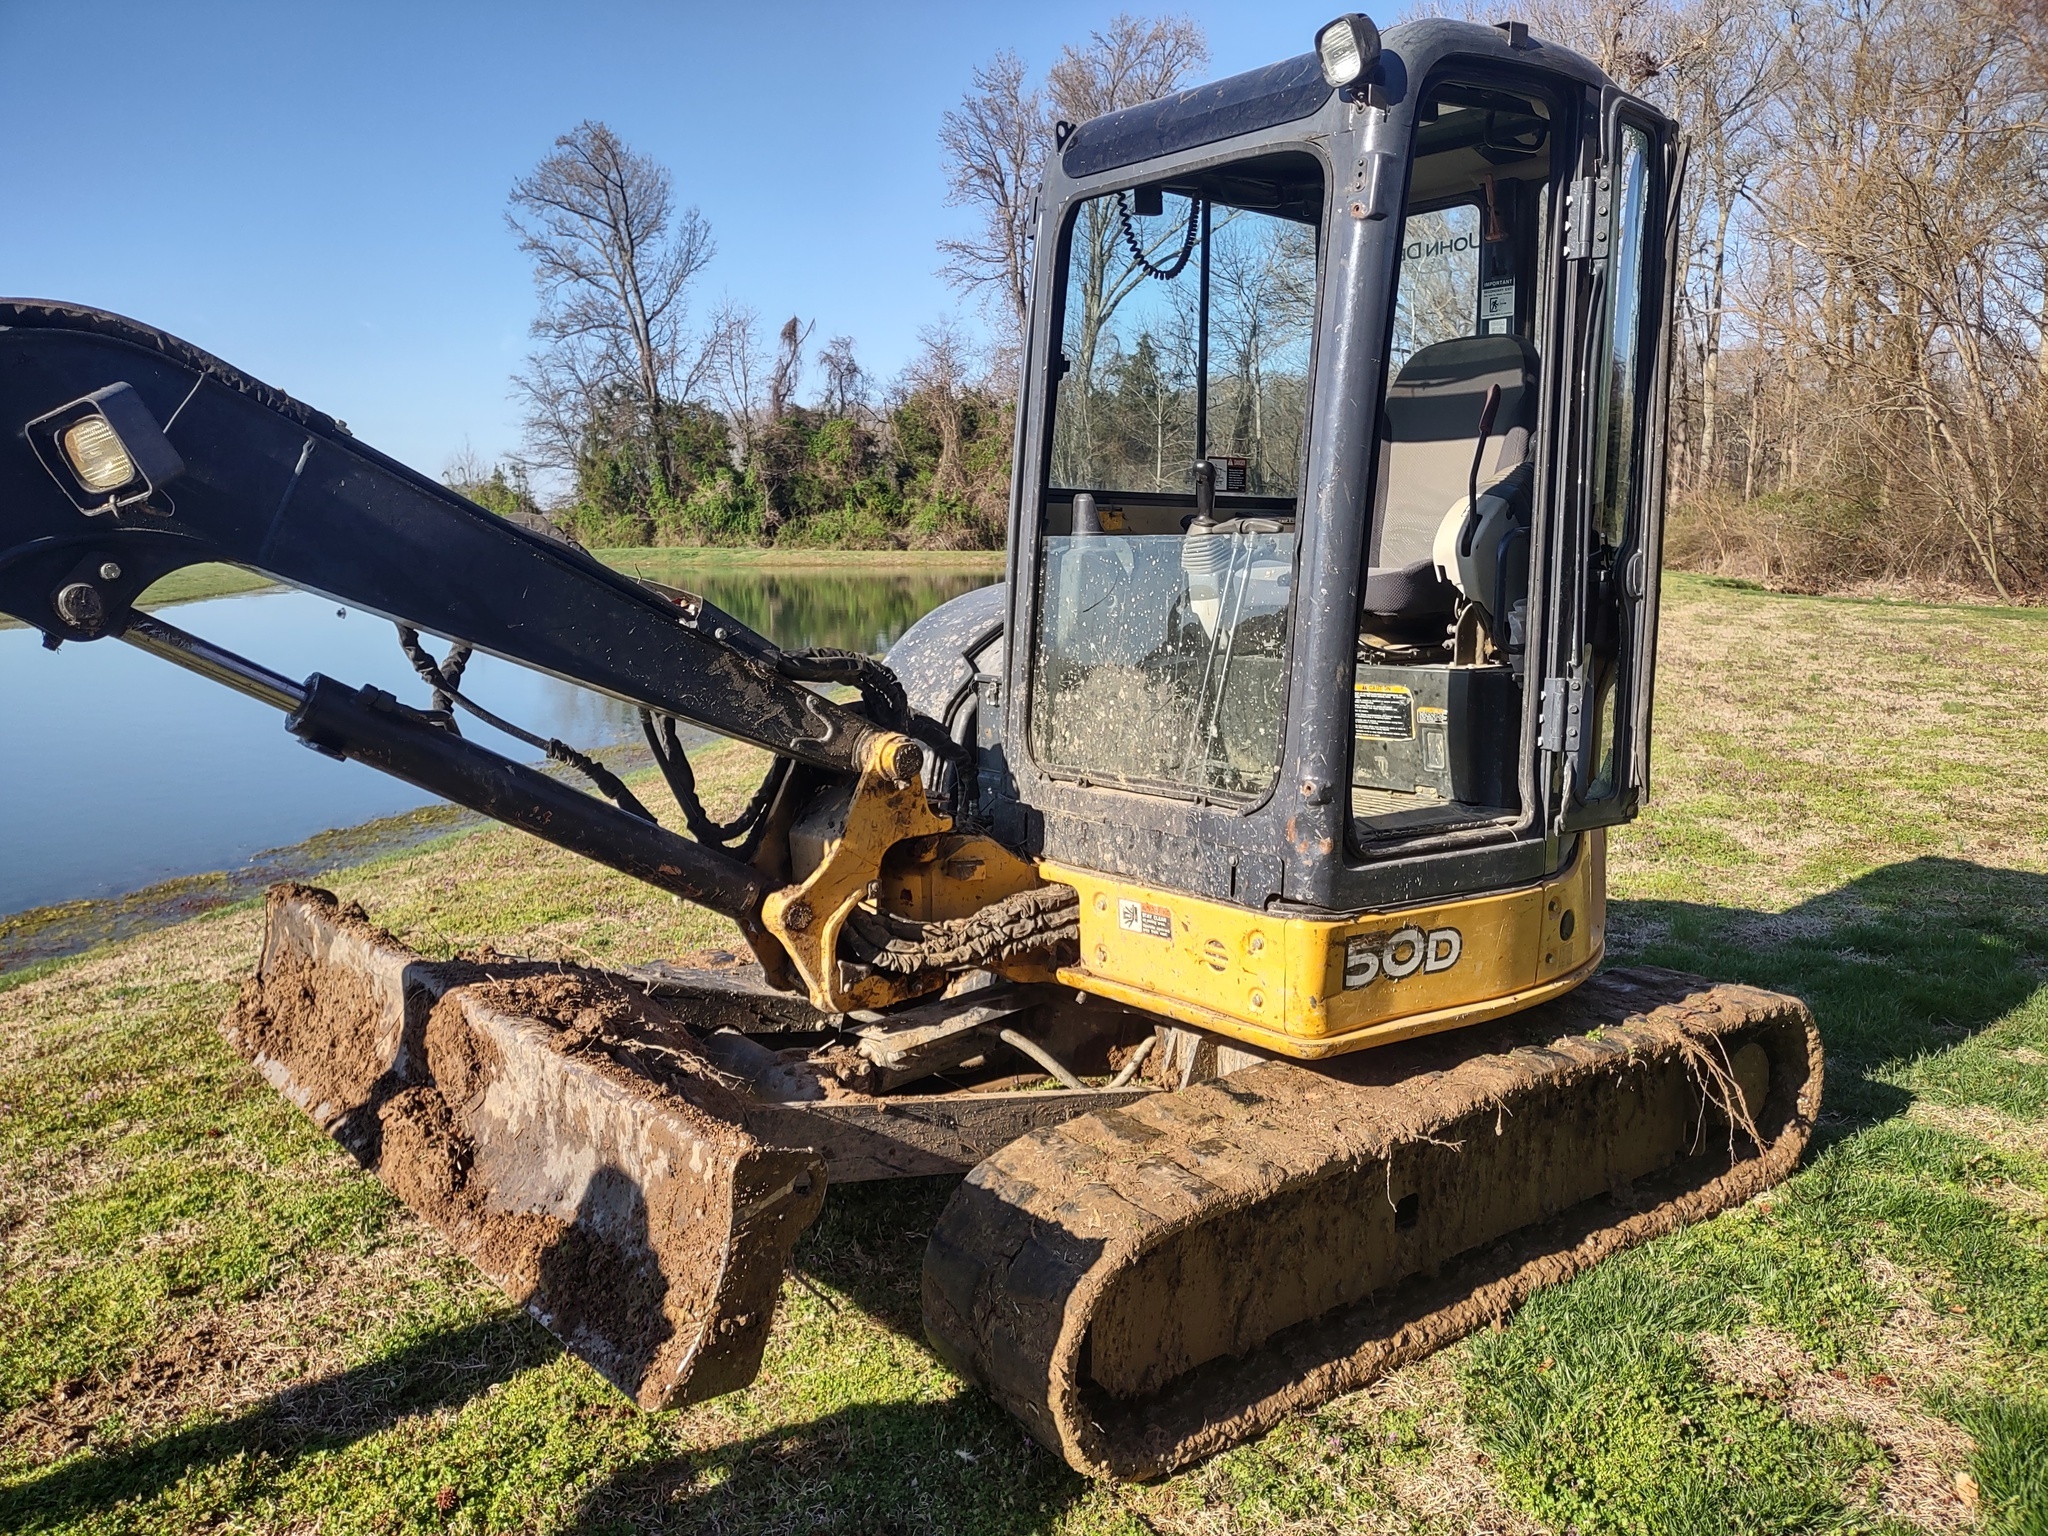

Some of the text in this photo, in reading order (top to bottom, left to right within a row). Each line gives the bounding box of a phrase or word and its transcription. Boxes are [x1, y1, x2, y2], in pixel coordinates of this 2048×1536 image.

[1484, 279, 1512, 287] IMPORTANT
[1153, 915, 1167, 923] CLEAR
[1343, 924, 1462, 991] 50D
